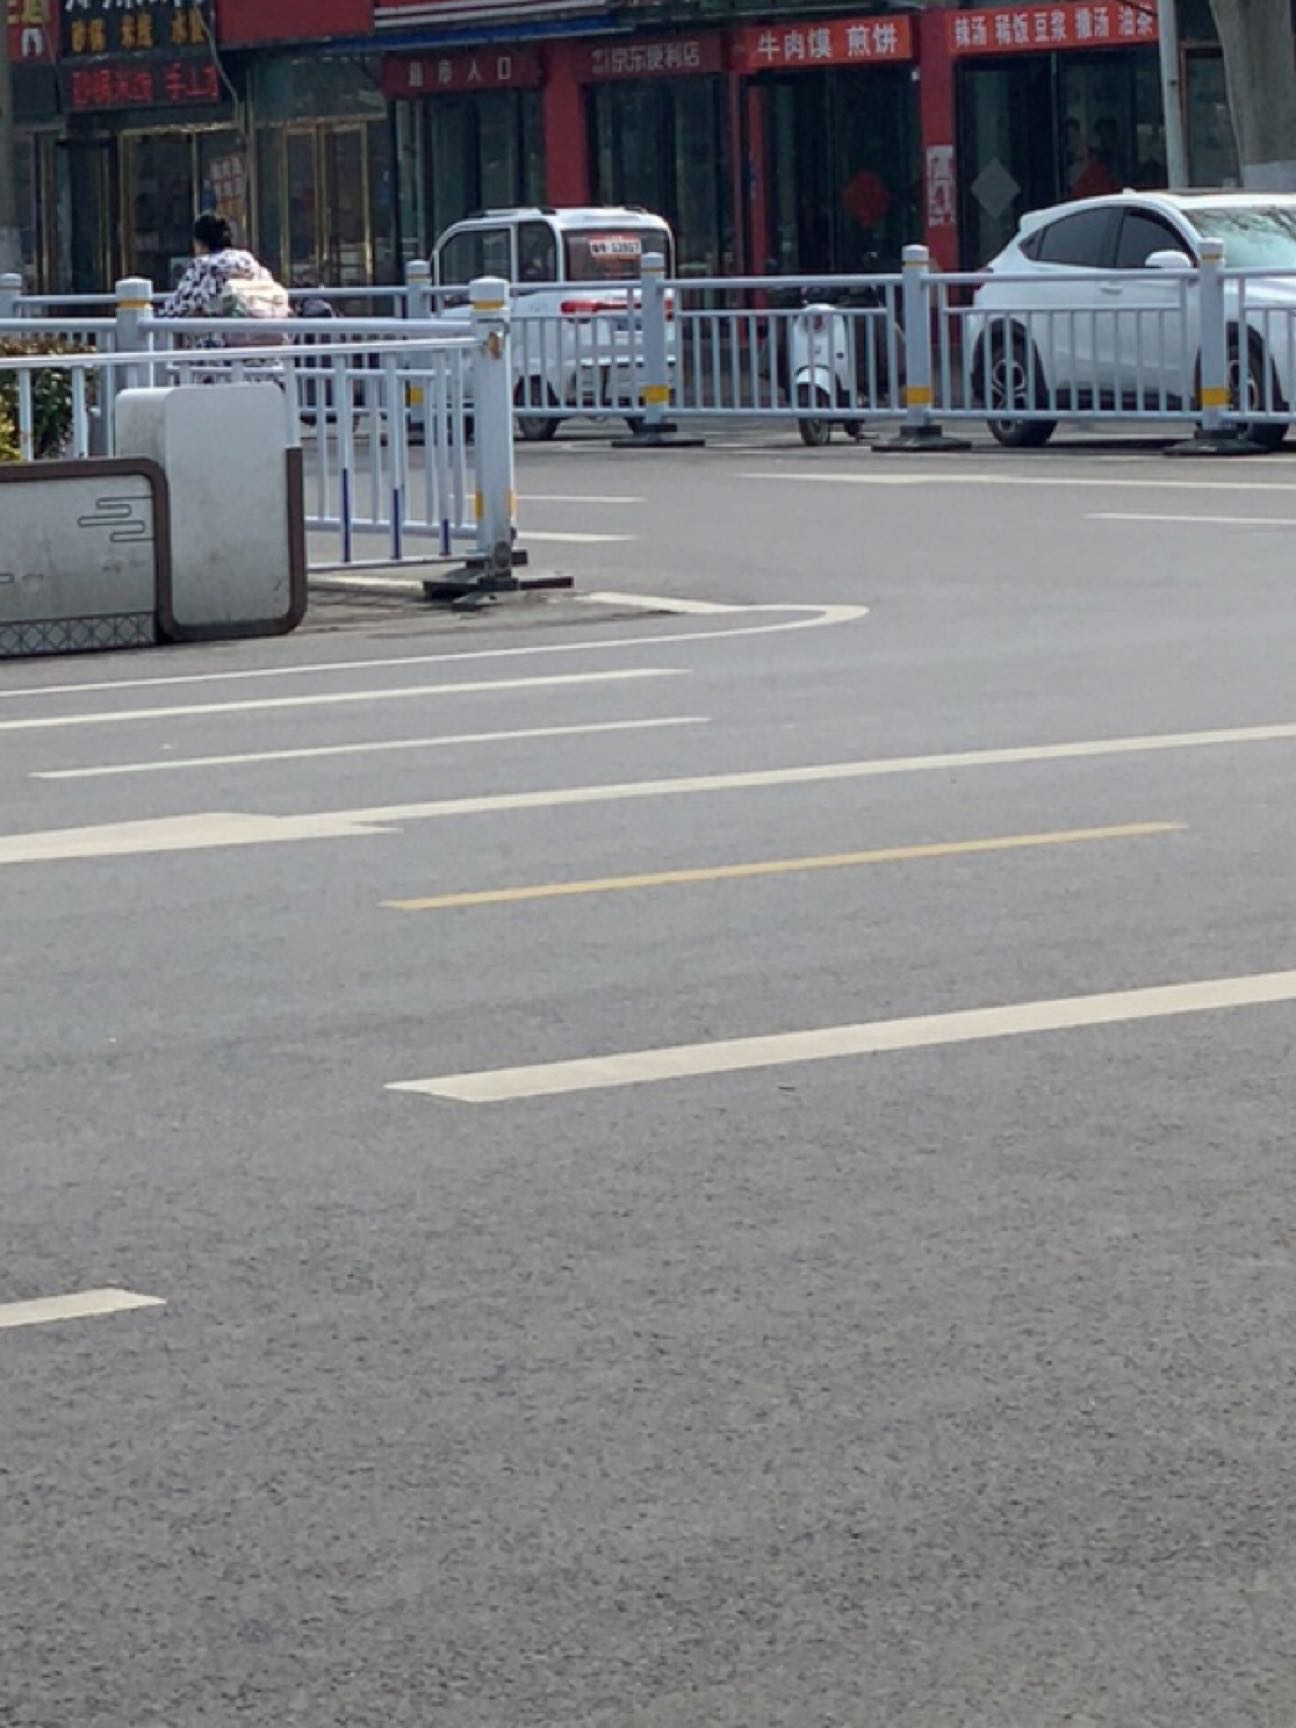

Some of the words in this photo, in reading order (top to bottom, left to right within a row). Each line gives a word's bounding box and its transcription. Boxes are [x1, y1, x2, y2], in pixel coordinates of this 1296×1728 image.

[757, 27, 834, 65] 牛肉馍
[845, 21, 899, 58] 煎饼
